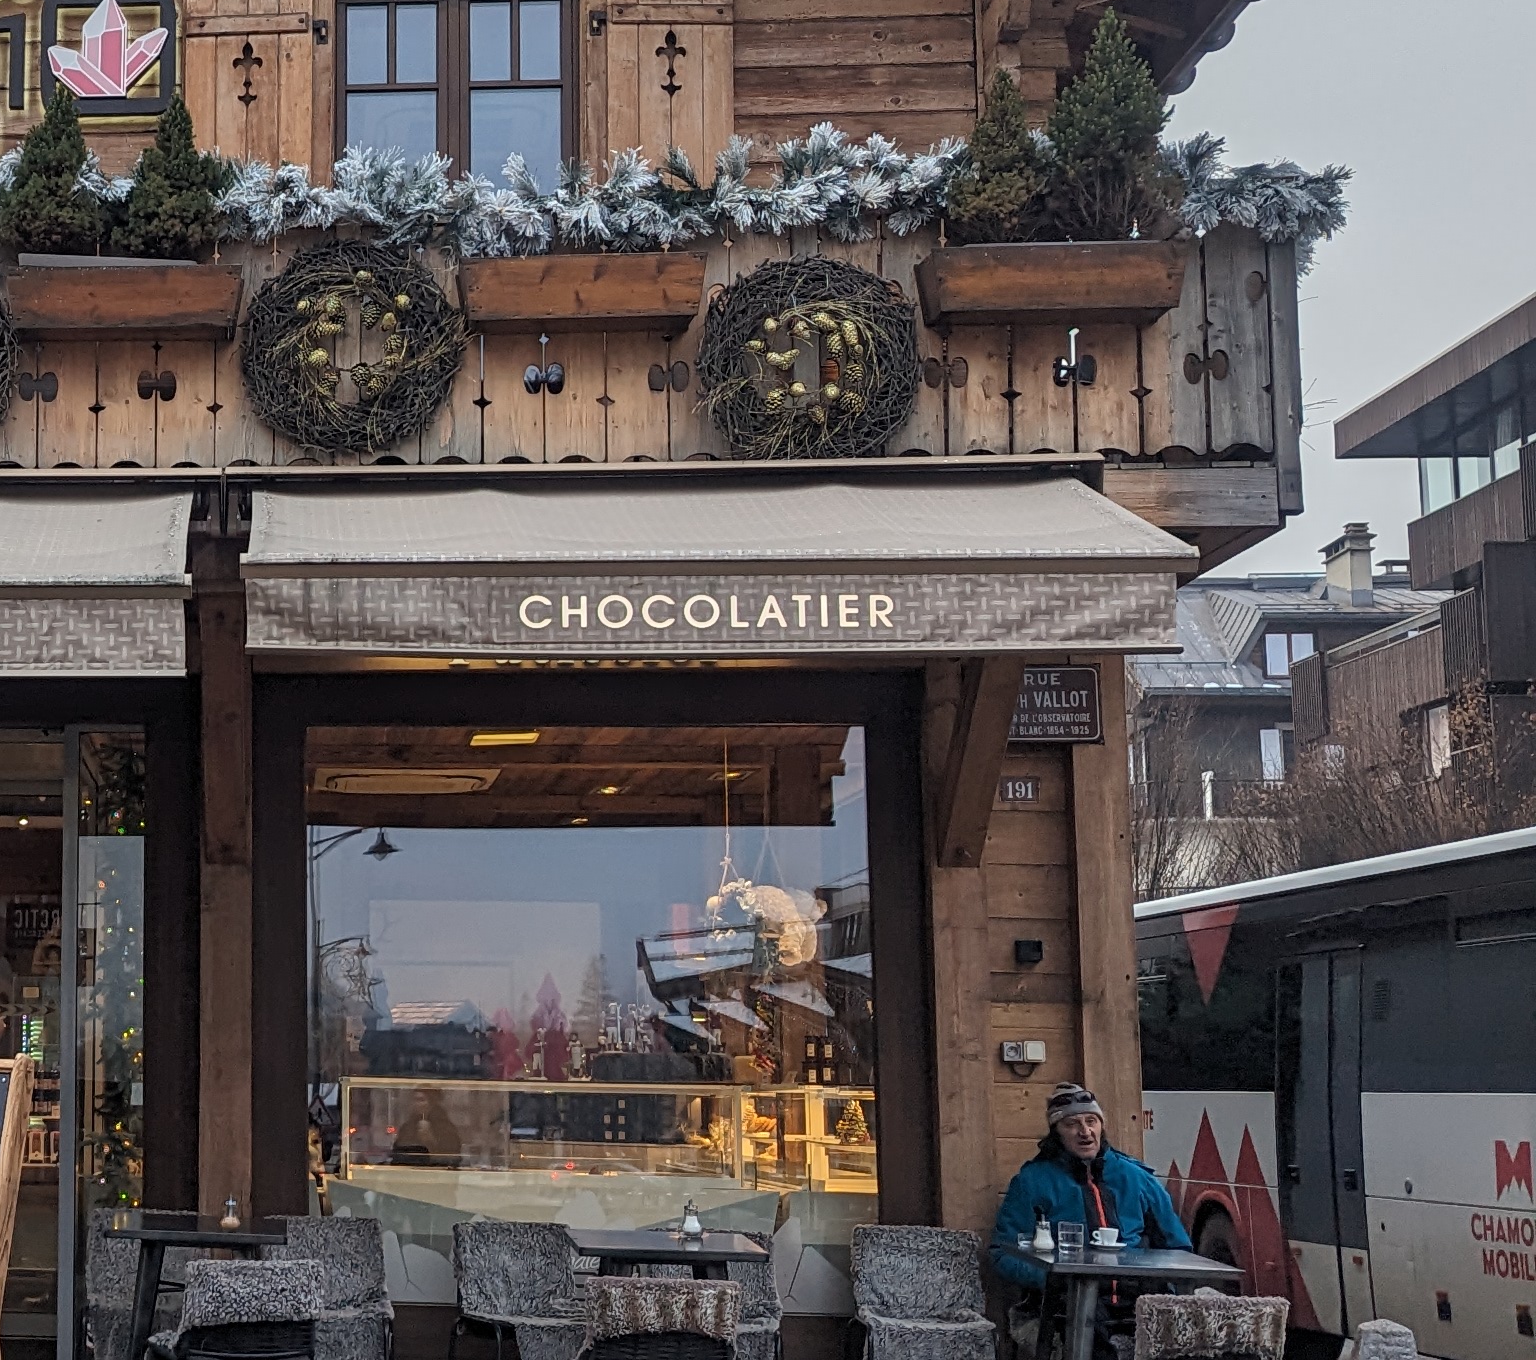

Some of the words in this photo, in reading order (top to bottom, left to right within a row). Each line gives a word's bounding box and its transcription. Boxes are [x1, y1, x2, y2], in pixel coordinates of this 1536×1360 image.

[519, 594, 894, 630] CHOCOLATIER
[1024, 673, 1061, 686] RUE
[1033, 691, 1088, 708] VALLOT
[1020, 714, 1030, 723] DE
[1032, 712, 1091, 723] L'OBSERVATOIRE
[1006, 781, 1033, 799] 191
[1471, 1212, 1536, 1247] CHAMO
[1482, 1248, 1536, 1281] MOBIL
